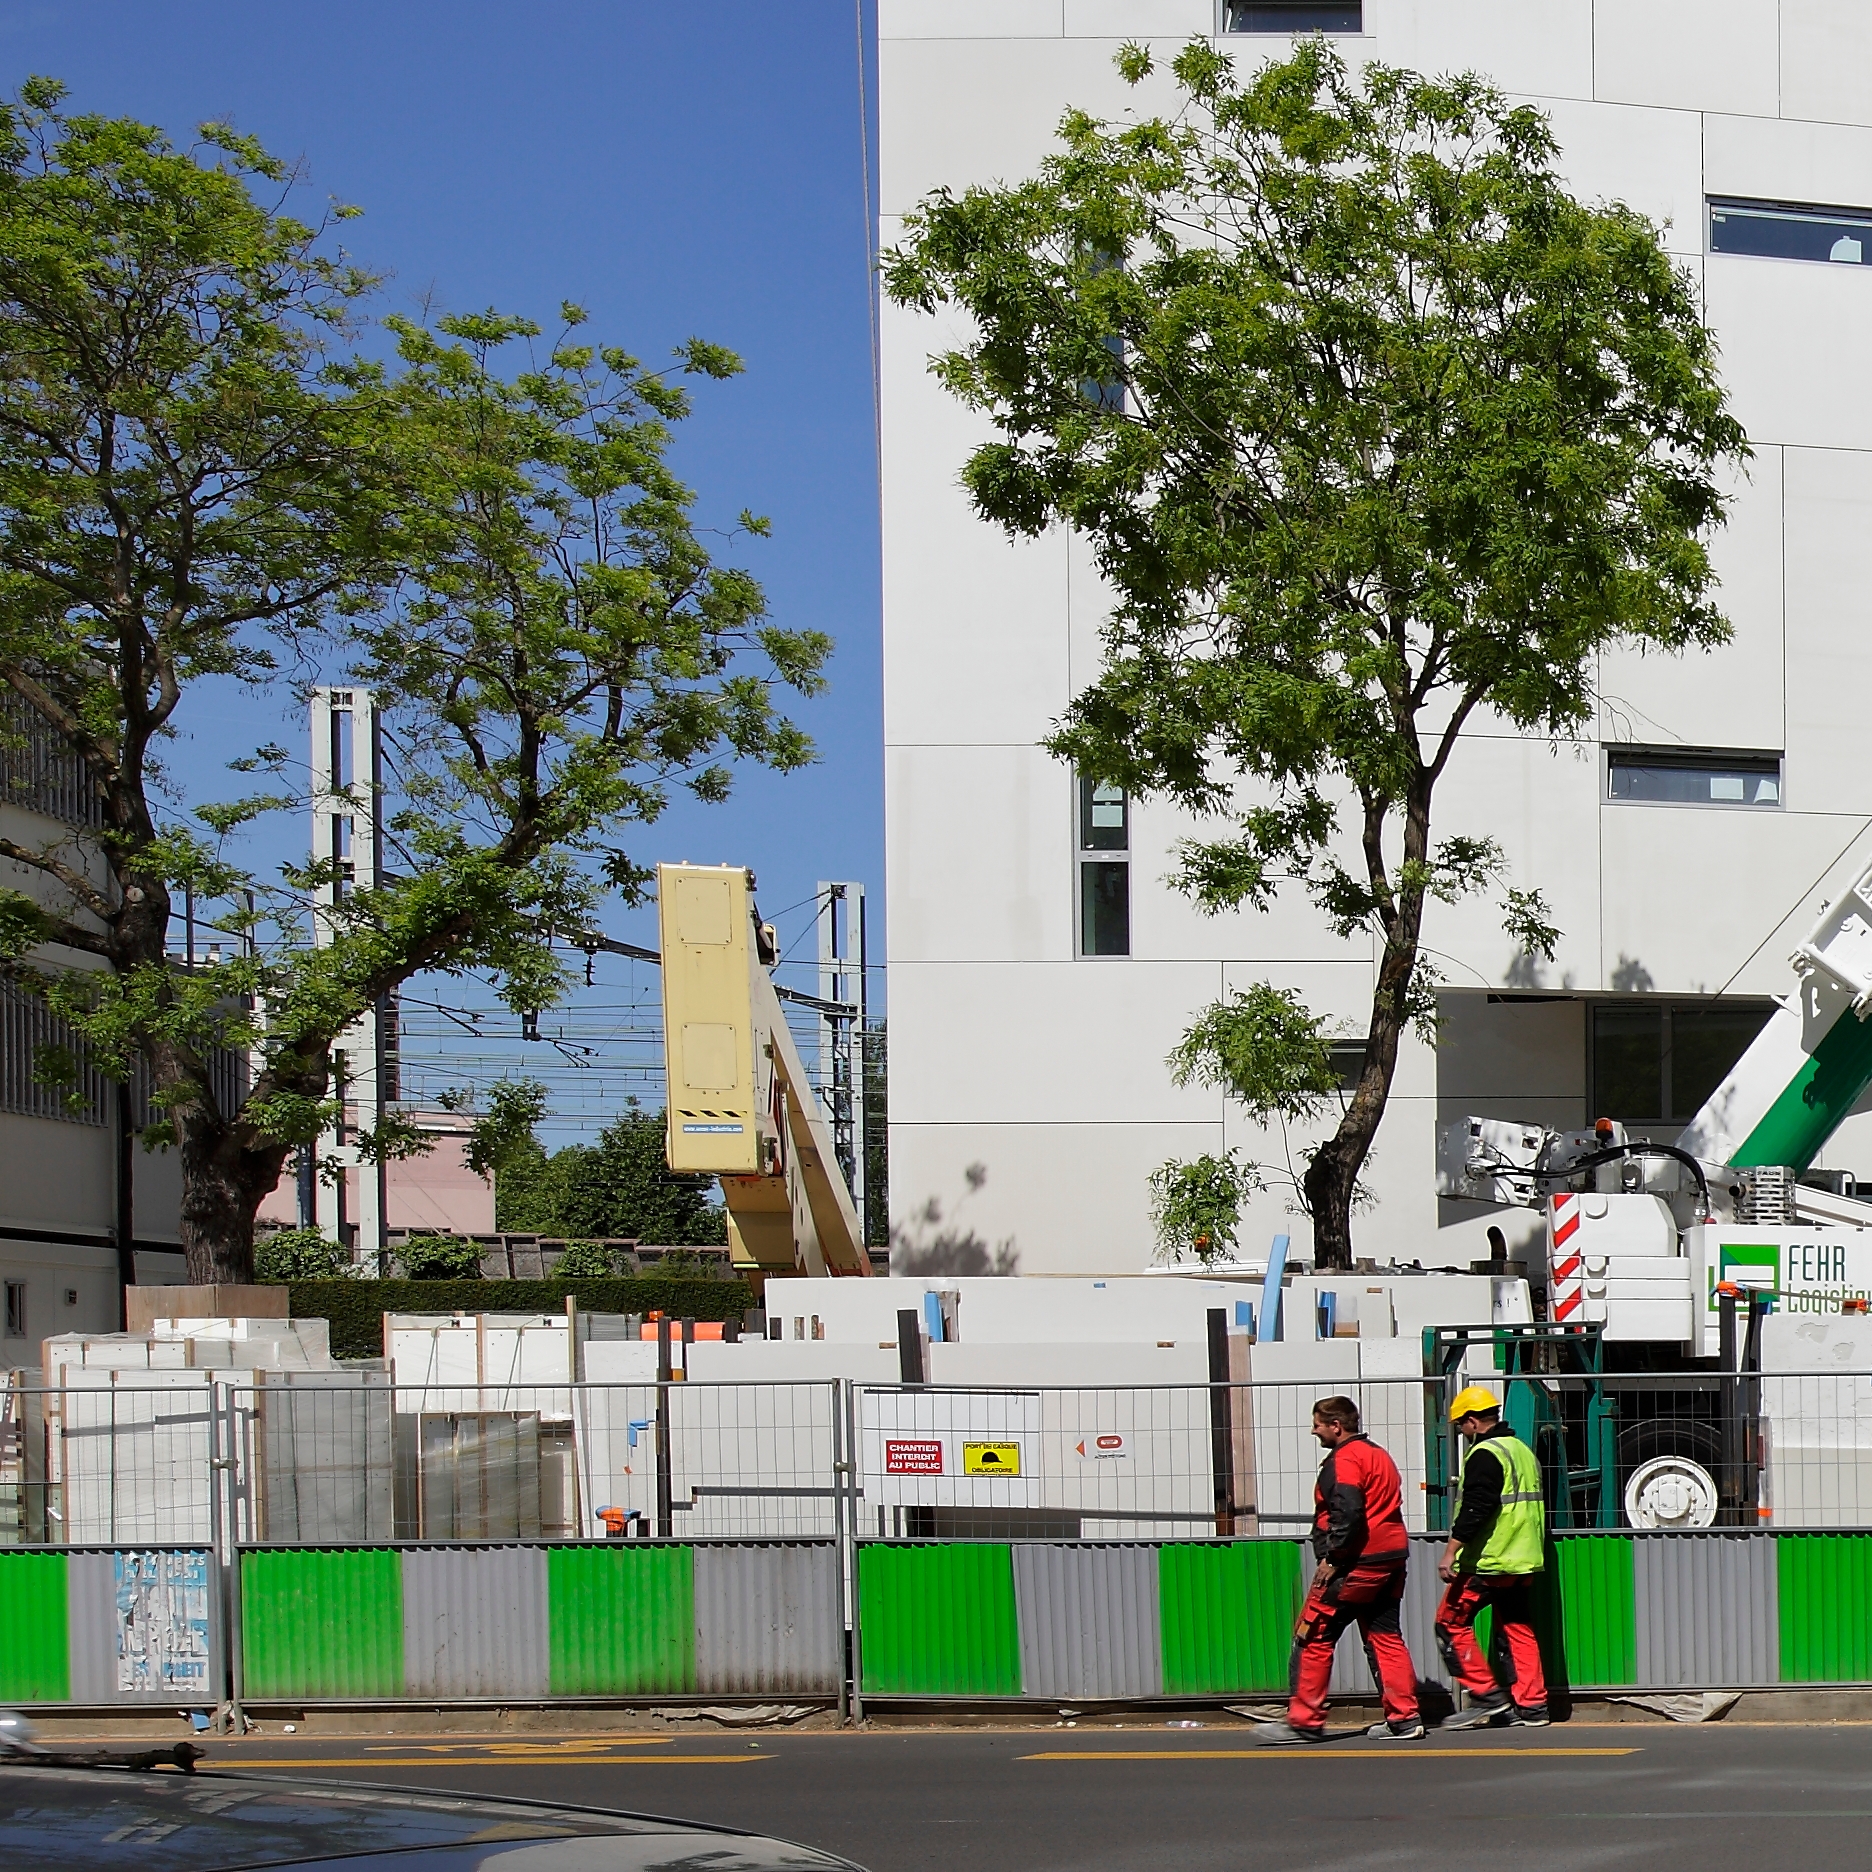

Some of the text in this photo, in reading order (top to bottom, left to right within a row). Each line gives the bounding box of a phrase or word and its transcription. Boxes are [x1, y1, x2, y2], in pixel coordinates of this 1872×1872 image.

[1788, 1245, 1846, 1282] FEHR
[889, 1444, 939, 1452] CHANTIER
[904, 1462, 941, 1470] PUBLIC
